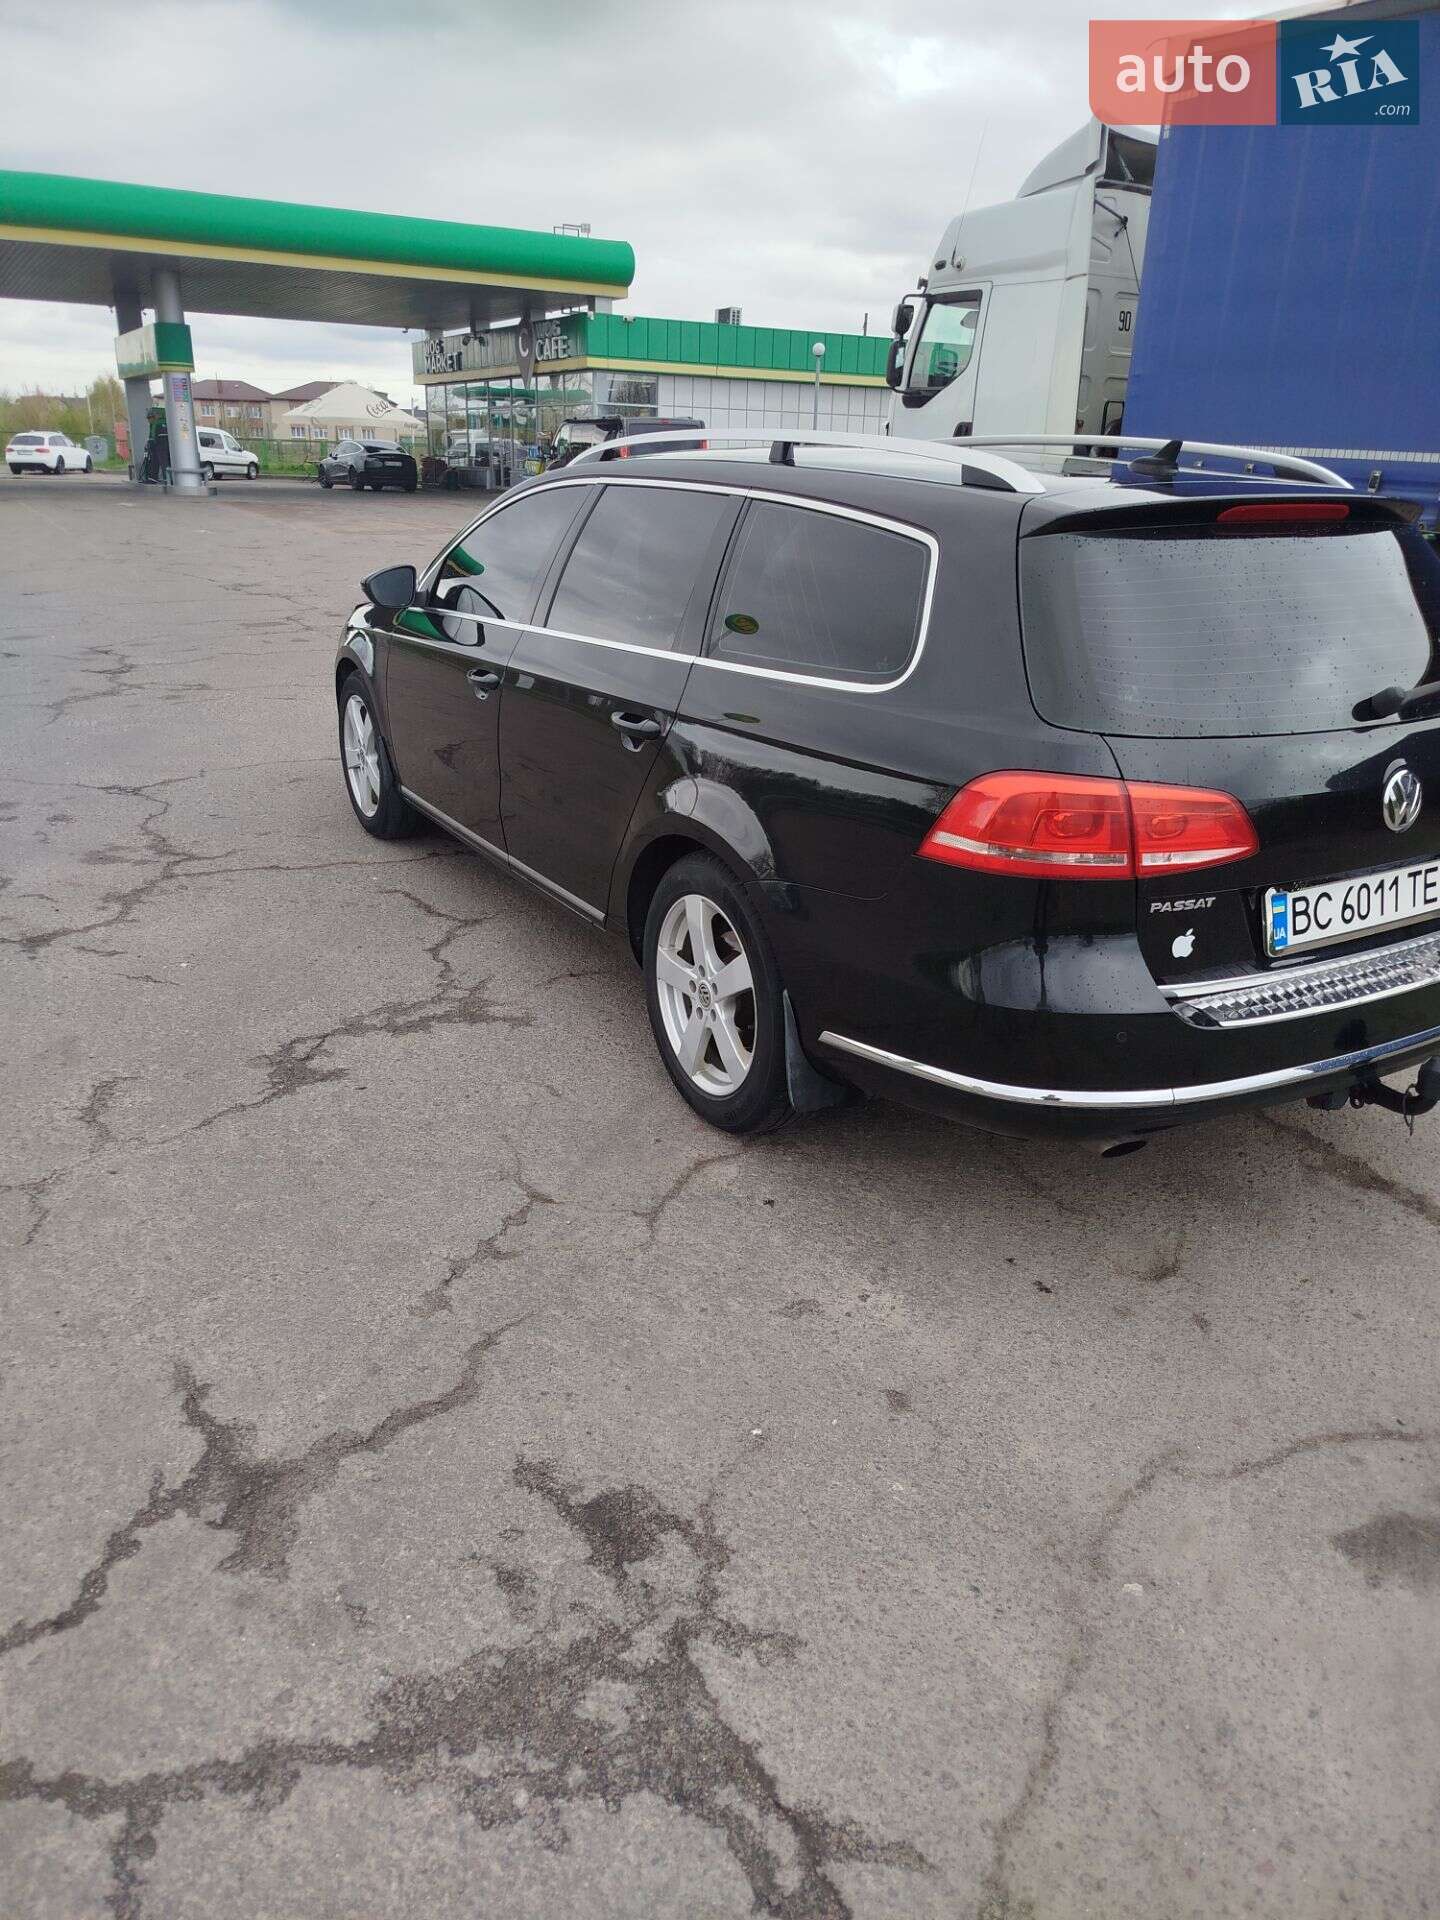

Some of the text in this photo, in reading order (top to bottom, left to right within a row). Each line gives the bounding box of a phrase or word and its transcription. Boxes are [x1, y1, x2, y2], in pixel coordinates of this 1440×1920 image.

[1118, 310, 1132, 331] 90
[535, 335, 568, 361] CAFE
[424, 351, 459, 375] MARKET
[1149, 896, 1217, 914] PASSAT
[1292, 866, 1439, 936] BC 6011 TE
[1273, 926, 1287, 940] UA
